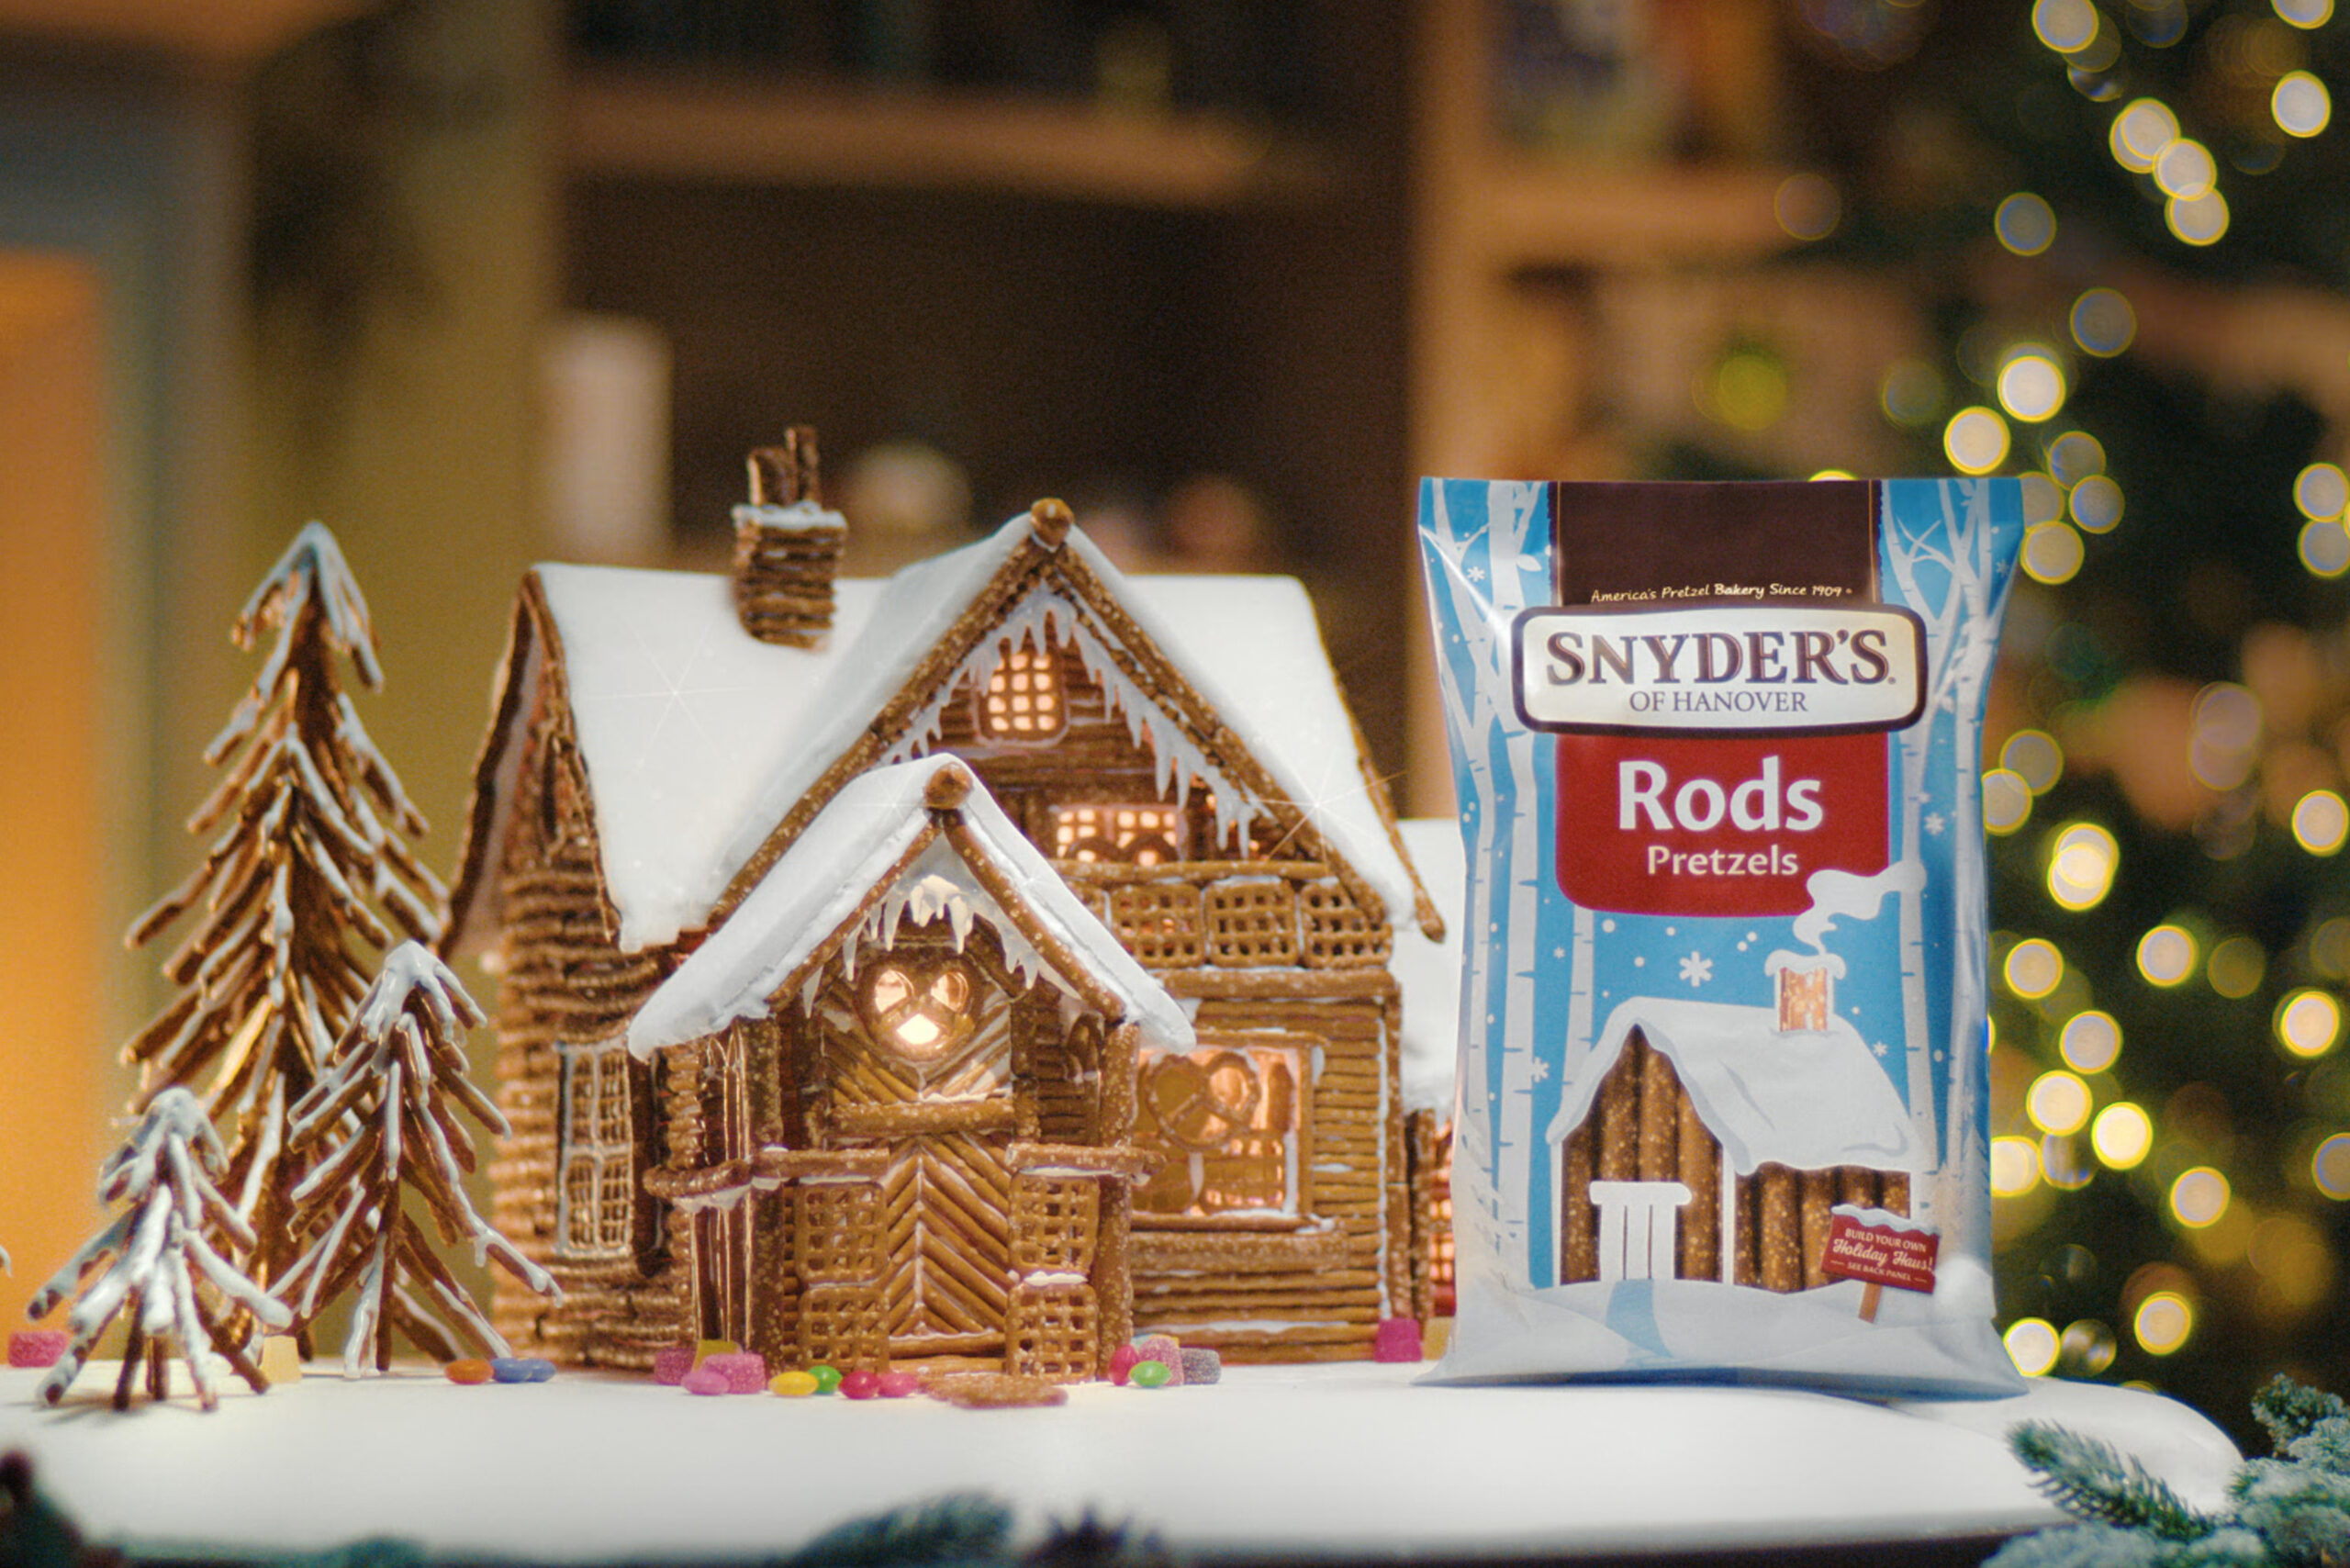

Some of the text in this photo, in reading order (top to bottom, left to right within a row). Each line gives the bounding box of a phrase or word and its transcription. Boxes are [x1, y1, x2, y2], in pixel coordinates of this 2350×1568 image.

[1591, 583, 1842, 602] America's Pretzel Bakery Since 1909
[1546, 629, 1890, 686] SNYDER'S
[1628, 690, 1808, 712] OF HANOVER
[1618, 755, 1824, 832] Rods
[1648, 844, 1799, 876] Pretzels
[1845, 1227, 1927, 1252] BUILD YOUR OWN
[1832, 1238, 1933, 1272] Holiday Haus!
[1847, 1261, 1911, 1282] SEE BACK PANEL
